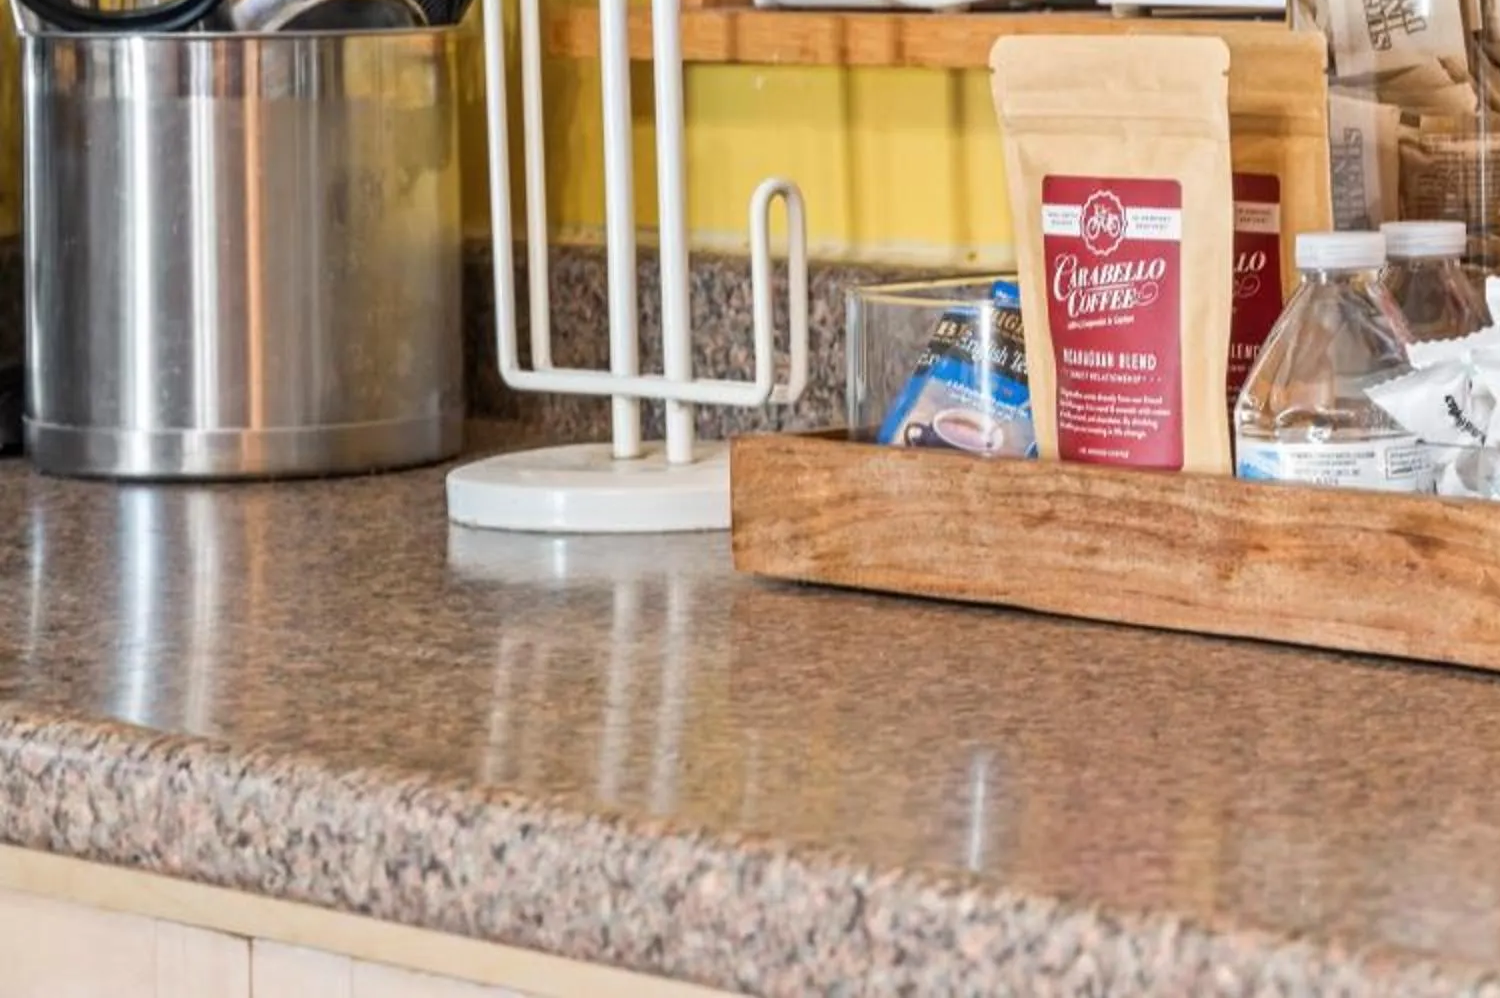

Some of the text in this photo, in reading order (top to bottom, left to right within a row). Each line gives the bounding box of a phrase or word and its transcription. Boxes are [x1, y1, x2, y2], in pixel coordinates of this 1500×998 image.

[1053, 253, 1167, 302] CARABELLO
[1067, 285, 1142, 318] COFFEE
[1118, 352, 1158, 371] BLEND
